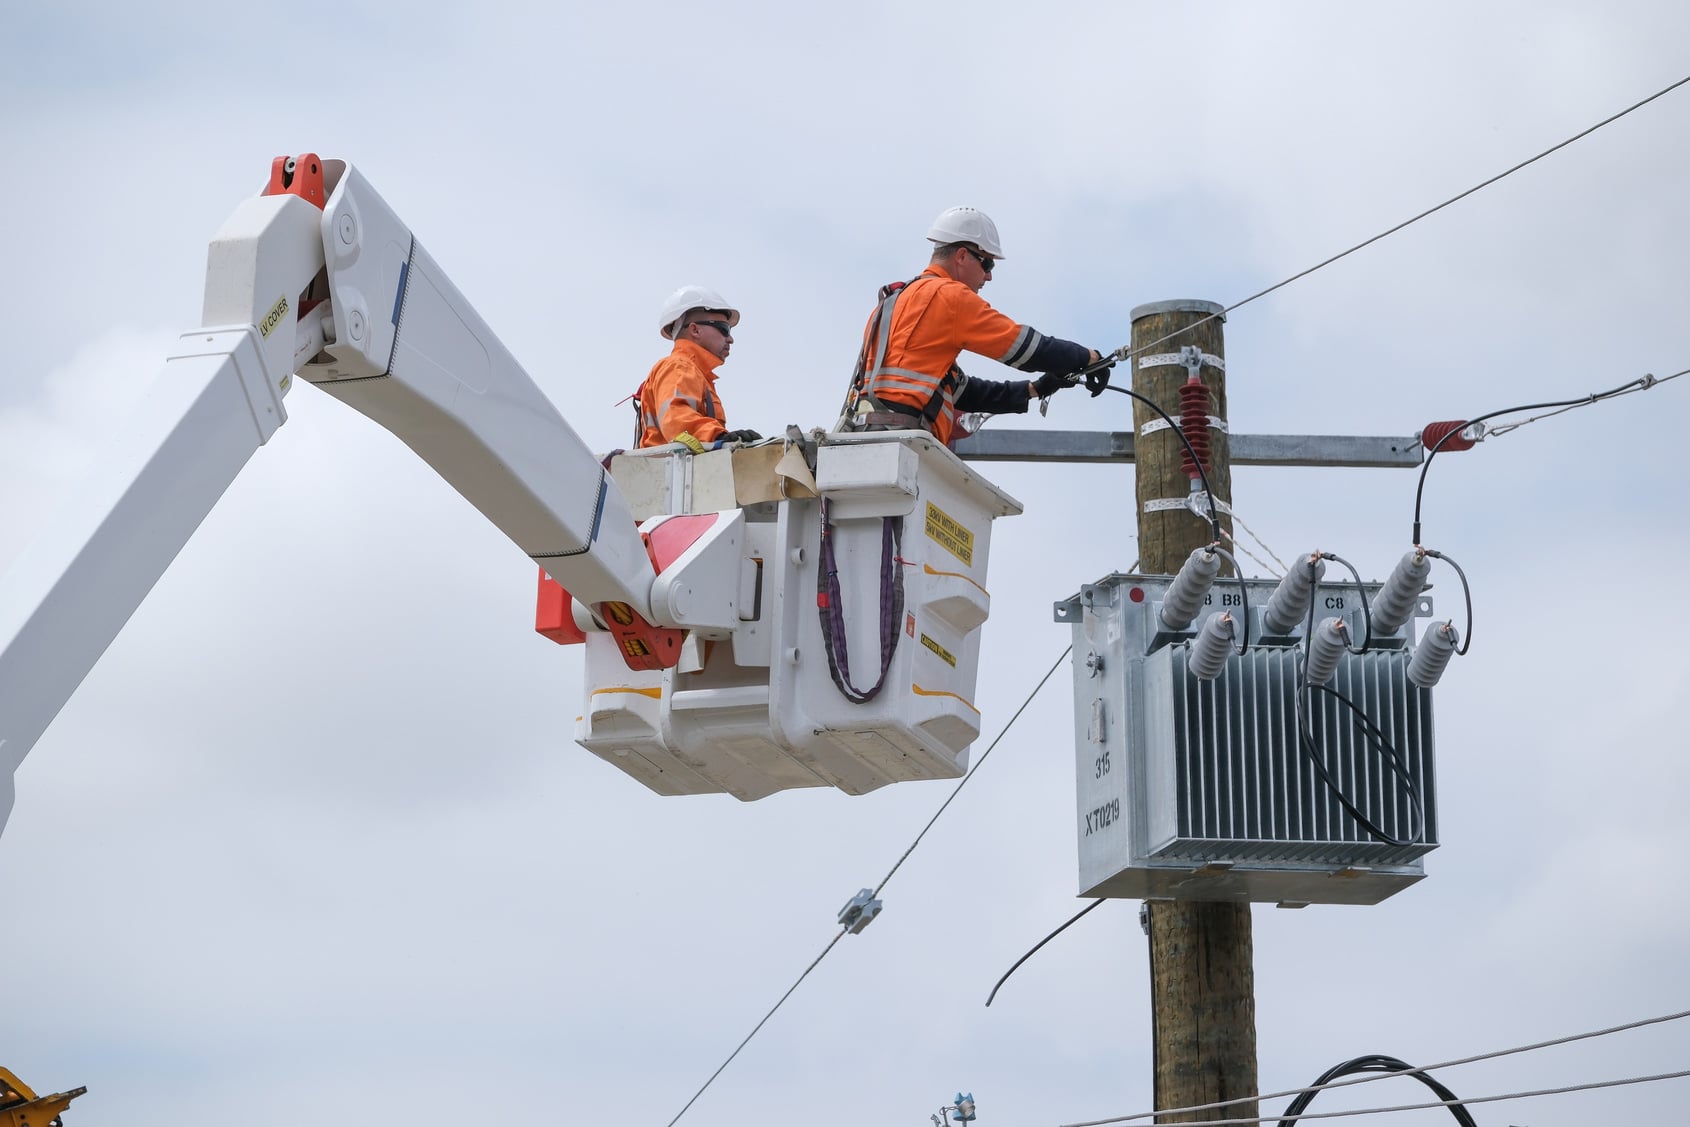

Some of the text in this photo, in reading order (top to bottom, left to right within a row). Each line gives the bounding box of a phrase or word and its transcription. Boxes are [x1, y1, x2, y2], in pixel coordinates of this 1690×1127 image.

[260, 298, 288, 337] LV COVER
[942, 514, 955, 533] WITH
[955, 525, 969, 544] LINER
[936, 528, 957, 552] WITHOUT
[957, 543, 971, 561] LINER
[1222, 593, 1241, 606] B8
[1325, 597, 1344, 609] C8
[1095, 751, 1111, 779] 315
[1085, 797, 1120, 837] XT0219
